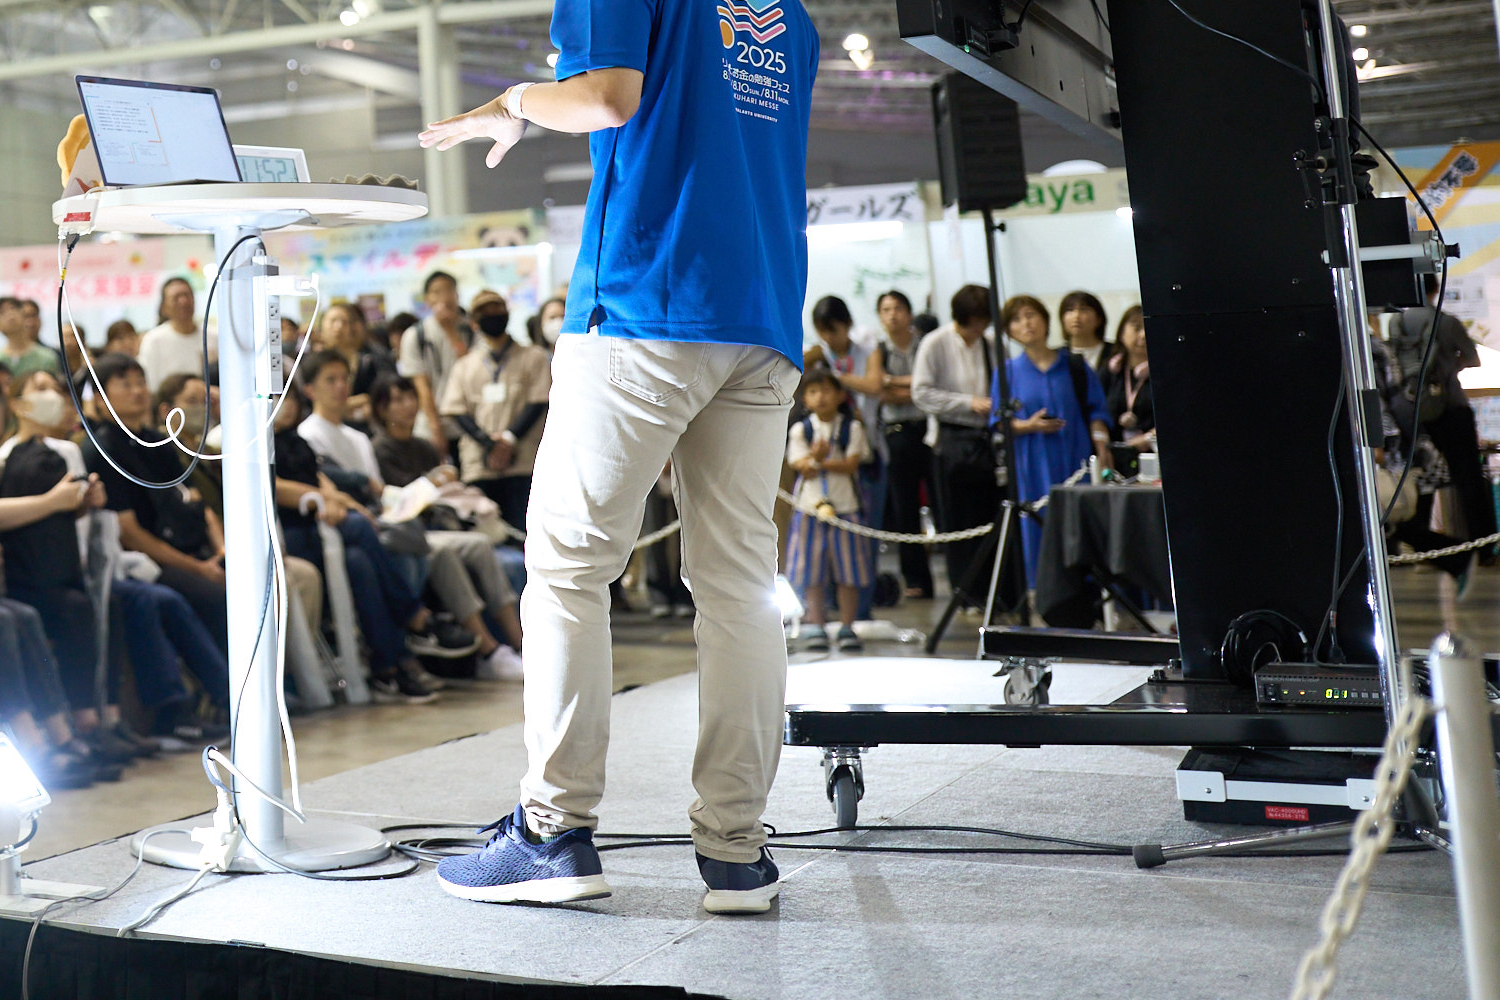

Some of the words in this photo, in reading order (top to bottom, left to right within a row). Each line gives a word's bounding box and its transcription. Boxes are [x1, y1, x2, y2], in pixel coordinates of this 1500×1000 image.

[736, 41, 786, 74] 2025
[733, 92, 757, 105] KUHARI
[758, 99, 780, 111] MESSE
